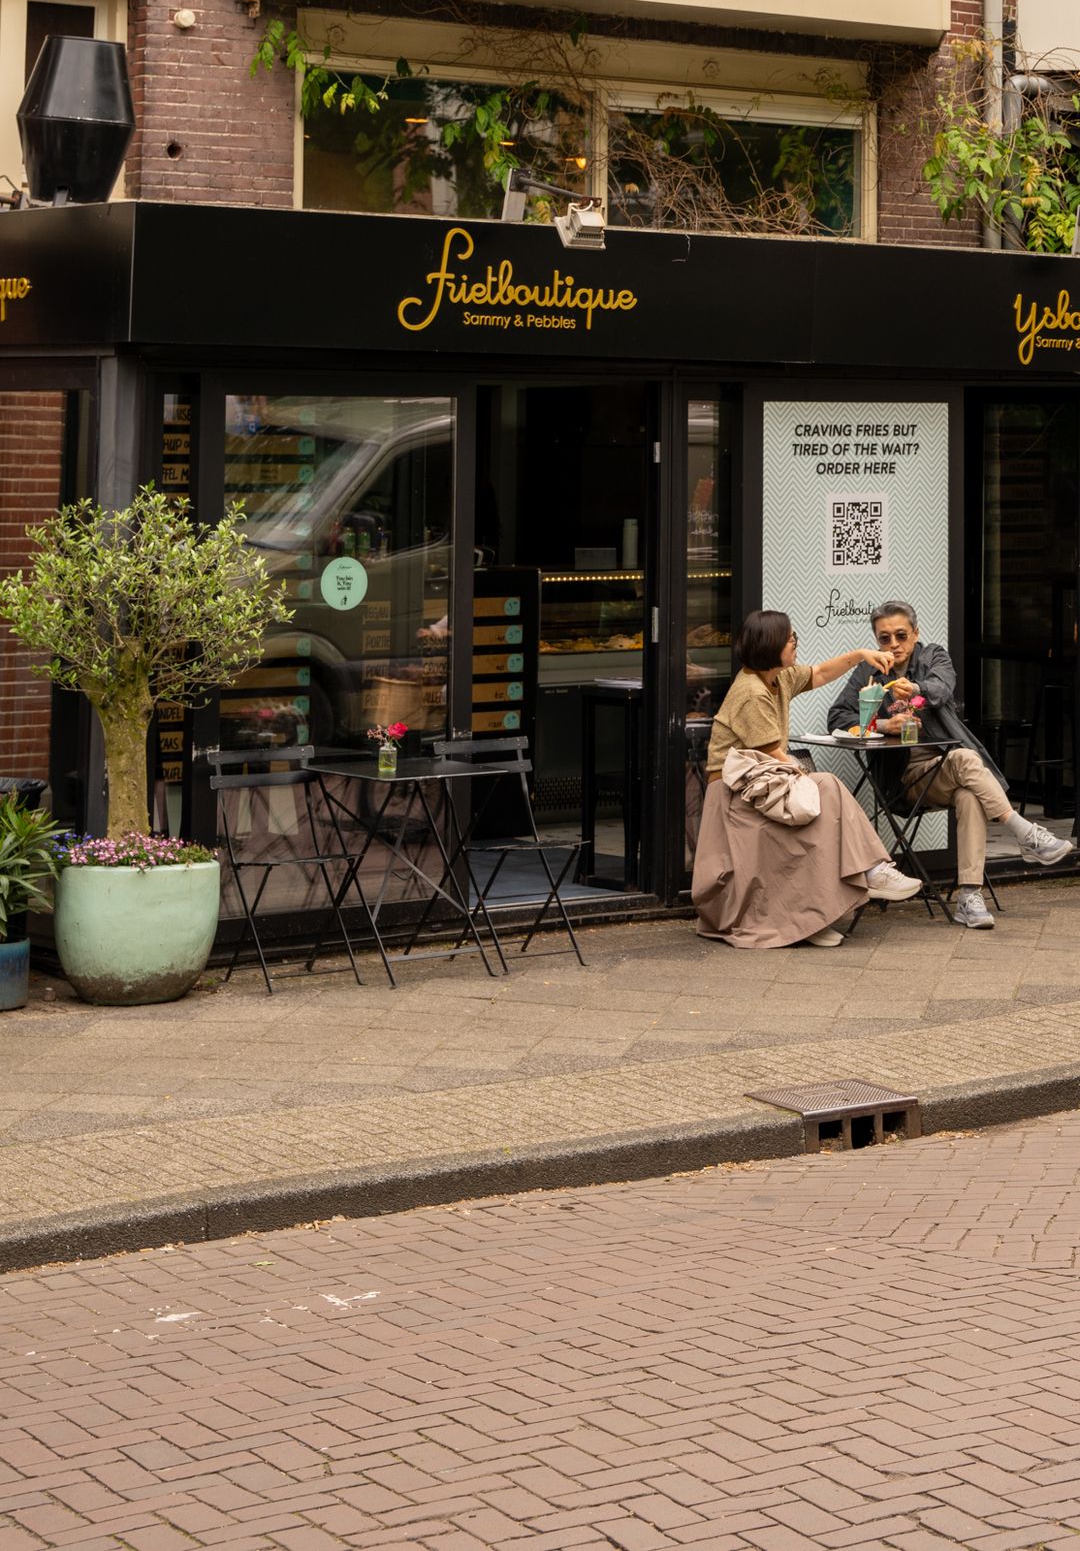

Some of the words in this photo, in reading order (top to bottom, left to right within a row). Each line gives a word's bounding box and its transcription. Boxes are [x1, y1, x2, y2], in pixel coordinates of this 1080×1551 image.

[463, 311, 511, 329] Sammy
[513, 313, 524, 327] &
[527, 314, 576, 330] Pebbles
[1035, 335, 1073, 351] Sammy
[794, 424, 852, 437] CRAVING
[855, 424, 890, 437] FRIES
[893, 424, 917, 437] BUT
[792, 443, 828, 456] TIRED
[832, 443, 850, 456] OF
[854, 443, 878, 456] THE
[881, 442, 920, 455] WAIT?
[816, 462, 860, 475] ORDER
[864, 462, 896, 474] HERE
